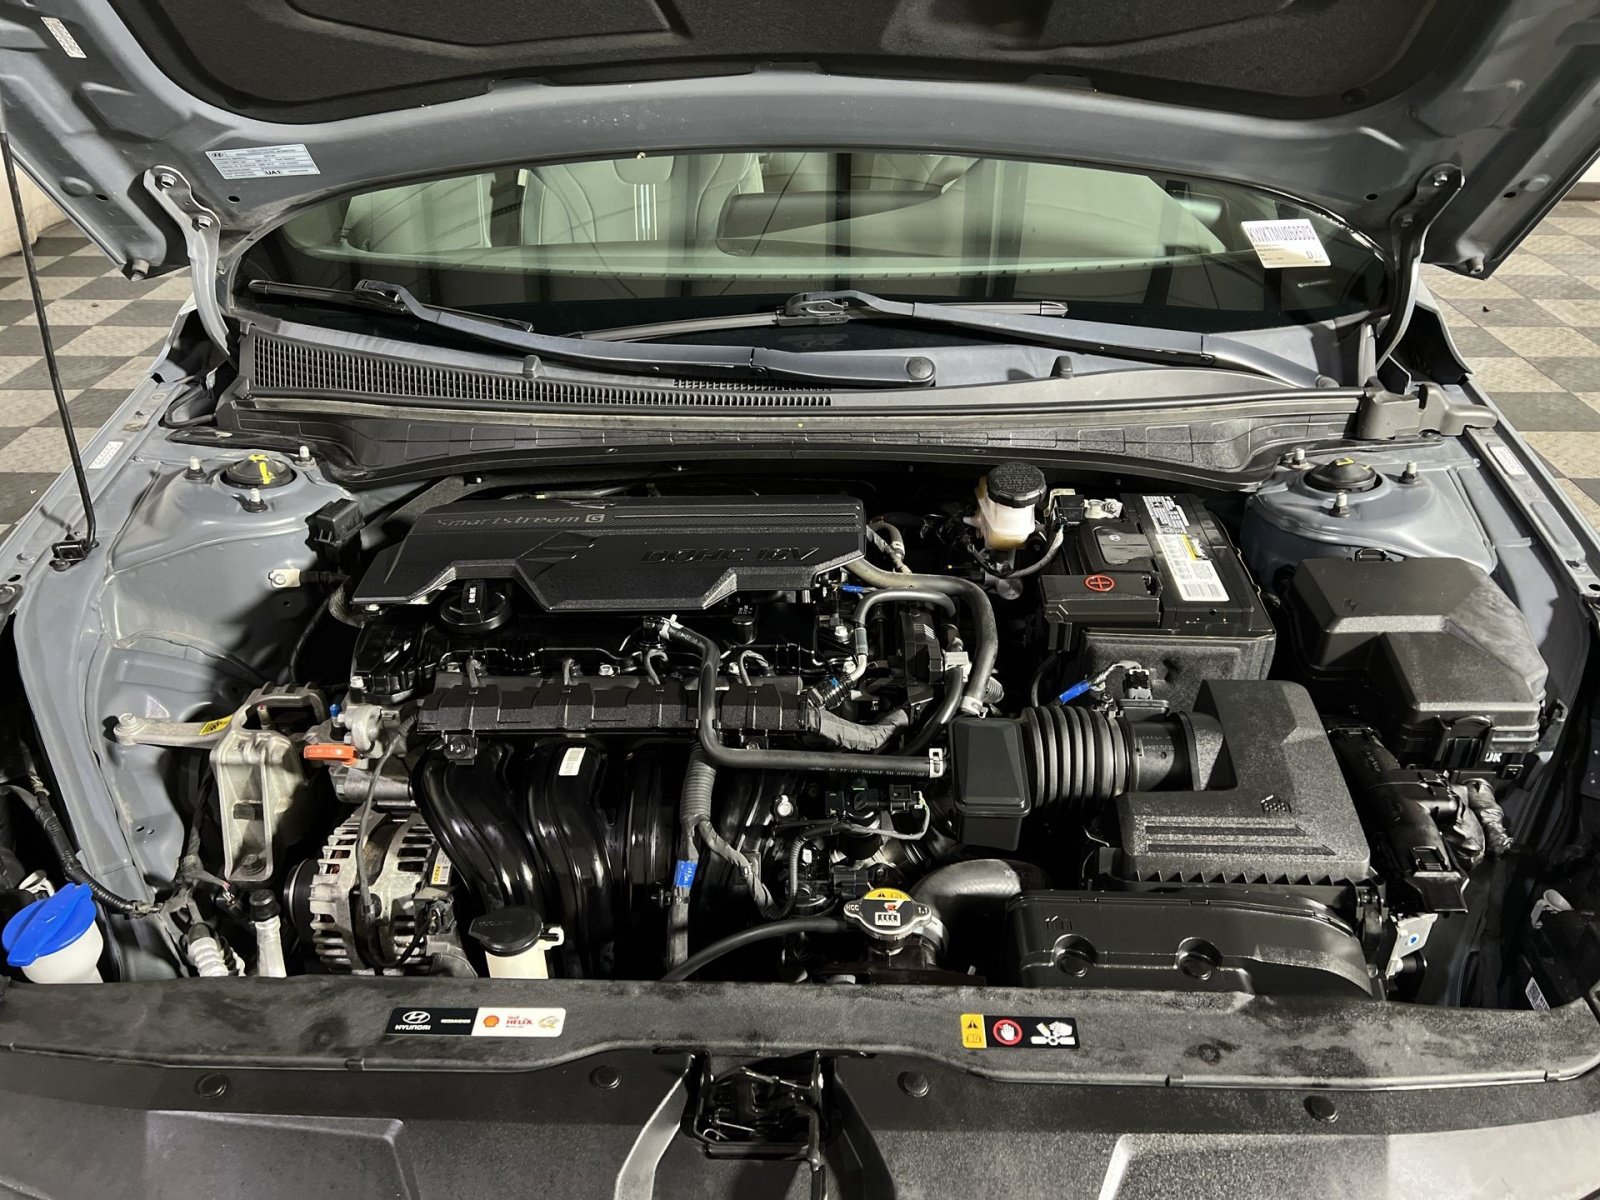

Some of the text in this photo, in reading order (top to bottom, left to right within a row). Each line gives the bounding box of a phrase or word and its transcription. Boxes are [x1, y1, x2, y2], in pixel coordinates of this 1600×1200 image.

[436, 515, 581, 527] Smartstream
[641, 547, 751, 563] DOHC
[917, 906, 928, 914] 1.1
